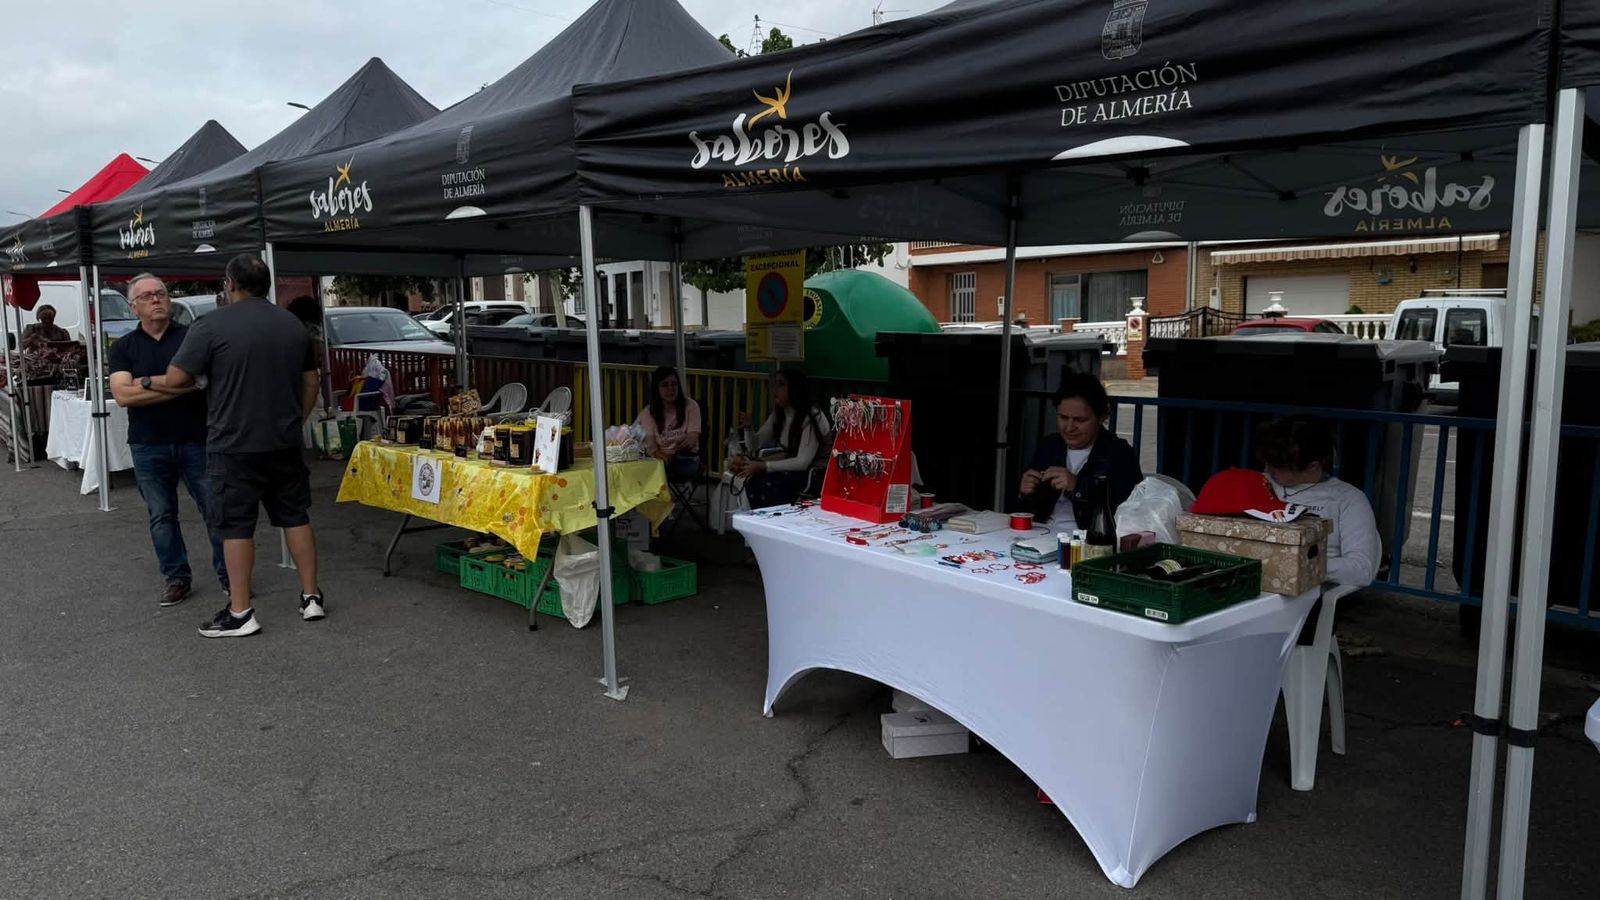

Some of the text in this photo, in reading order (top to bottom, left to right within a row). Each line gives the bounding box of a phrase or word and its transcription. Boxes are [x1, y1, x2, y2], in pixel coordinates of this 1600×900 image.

[1053, 61, 1198, 102] DIPUTACIÓN
[1060, 86, 1193, 127] DE ALMERÍA
[688, 111, 850, 170] sabores
[441, 167, 486, 186] DIPUTACIÓN
[443, 183, 486, 200] DE ALMERÍA
[720, 164, 808, 188] ALMERÍA
[309, 176, 374, 219] sabores
[324, 215, 361, 232] ALMERÍA
